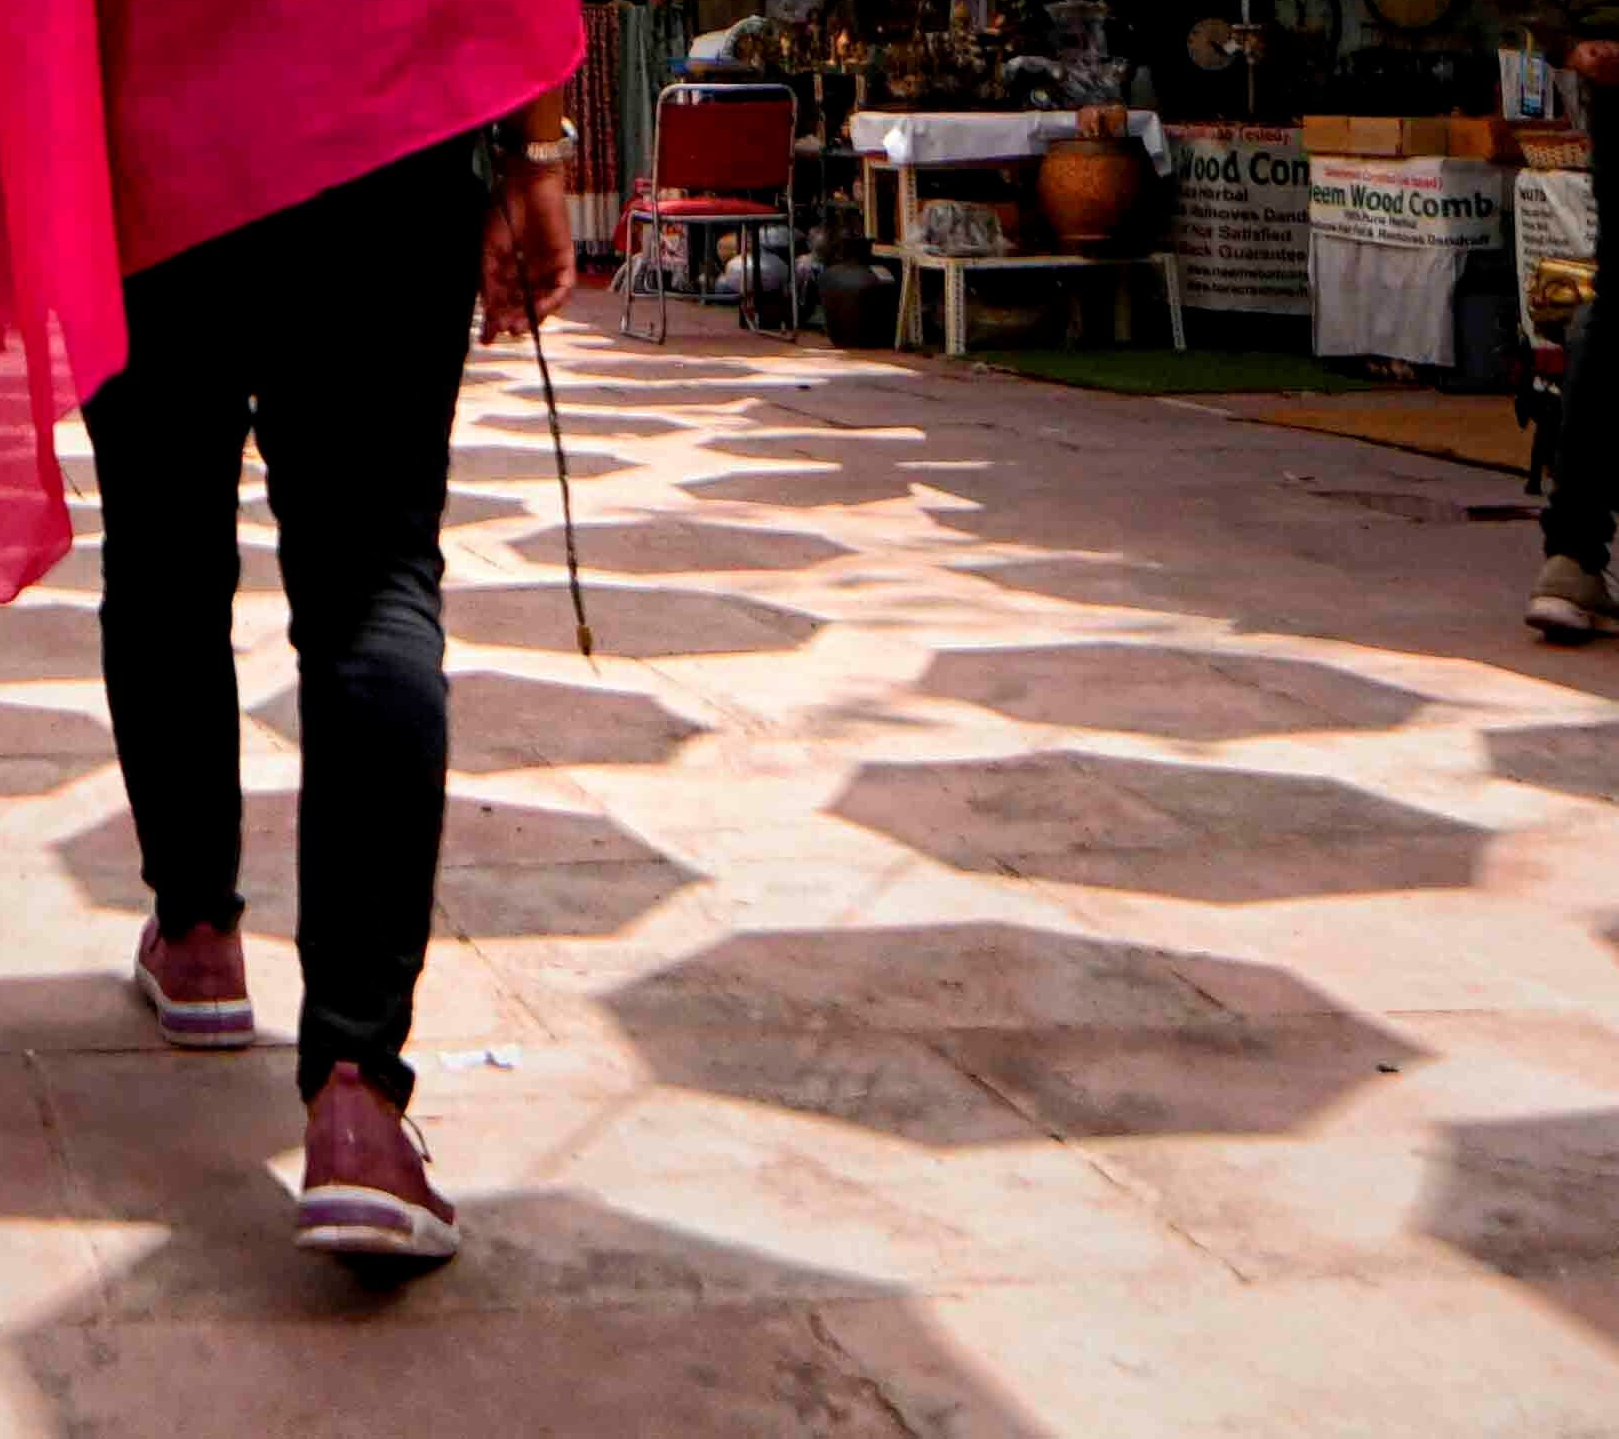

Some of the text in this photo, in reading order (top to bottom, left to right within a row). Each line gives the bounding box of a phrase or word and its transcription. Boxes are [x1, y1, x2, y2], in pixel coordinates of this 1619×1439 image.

[1350, 184, 1405, 214] Wood
[1408, 191, 1495, 219] Comb
[1265, 208, 1309, 223] Dand
